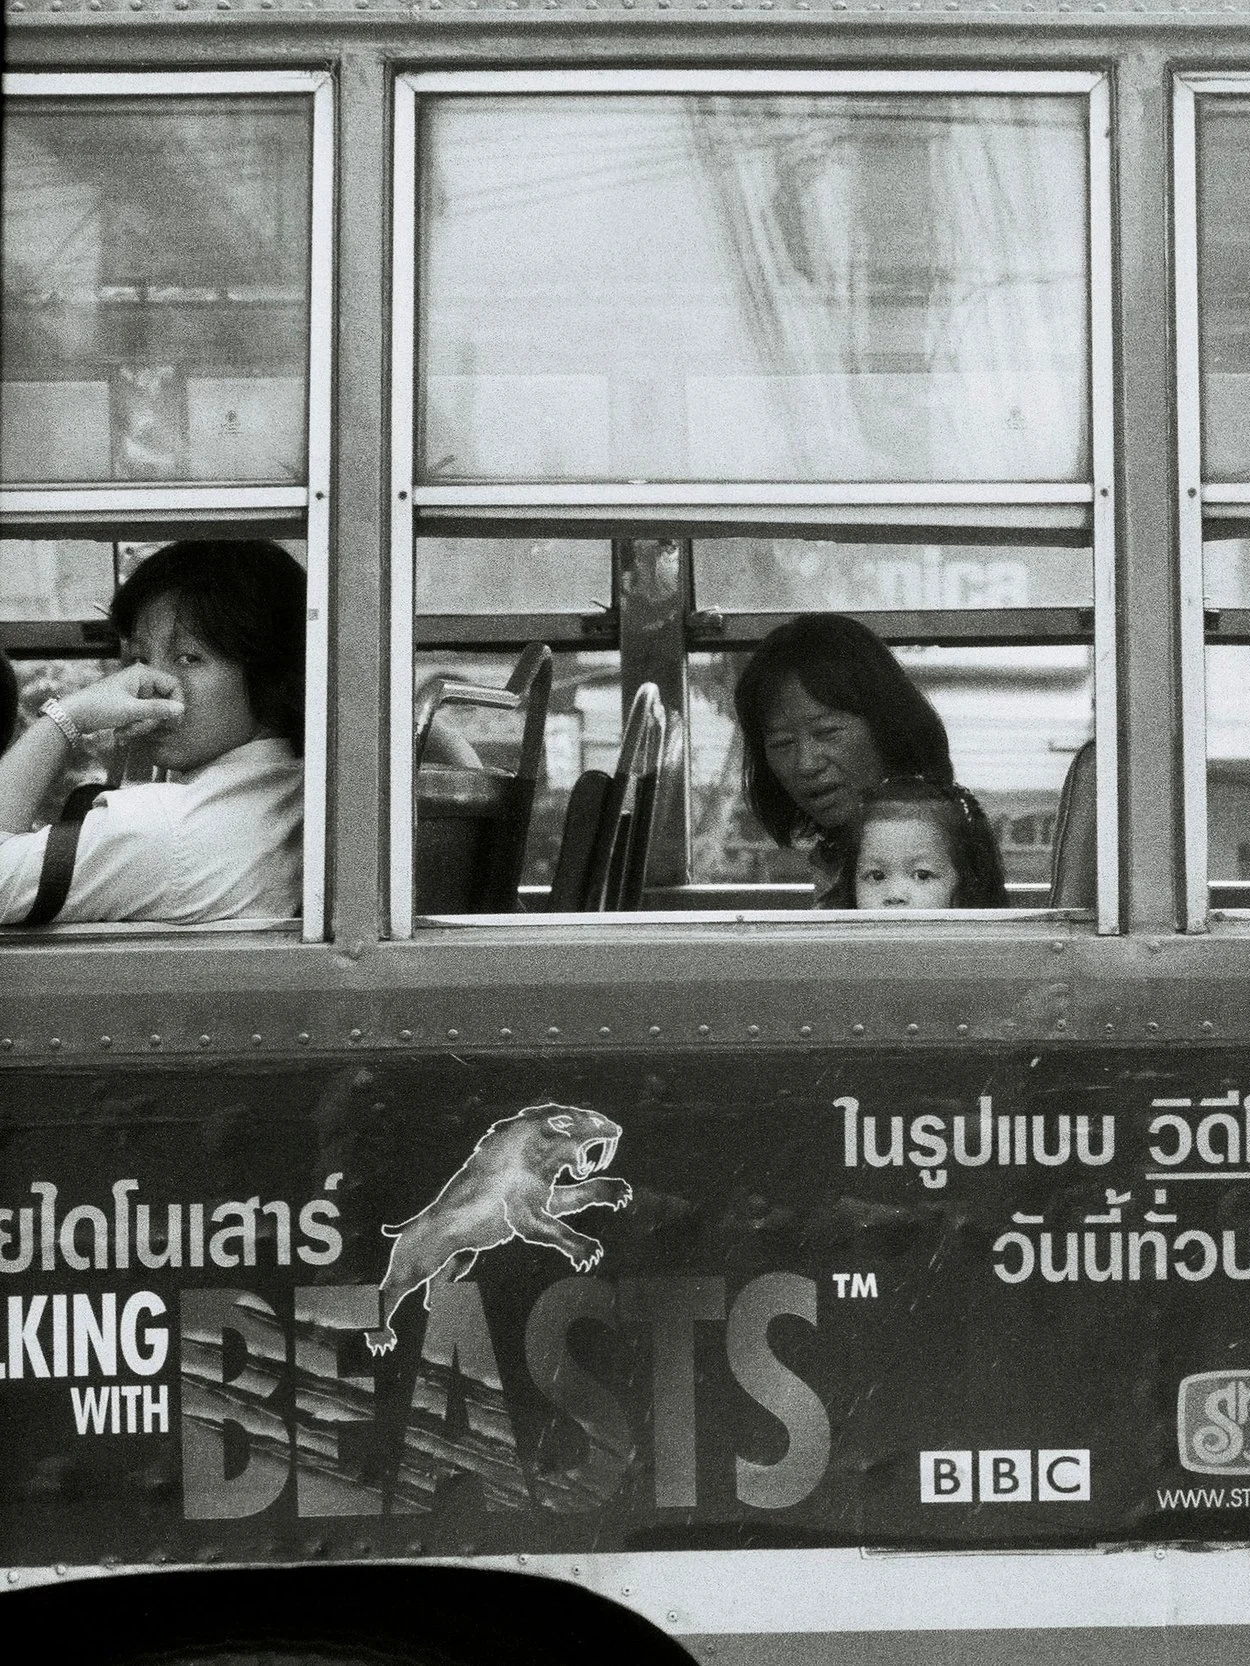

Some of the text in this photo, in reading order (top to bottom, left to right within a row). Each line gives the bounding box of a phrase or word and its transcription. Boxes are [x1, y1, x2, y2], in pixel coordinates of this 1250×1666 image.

[832, 1096, 1115, 1188] ในรูปแบบ
[0, 1290, 169, 1379] KING
[70, 1385, 169, 1435] WITH
[180, 1272, 831, 1519] BEASTS
[933, 1455, 1081, 1496] BBC
